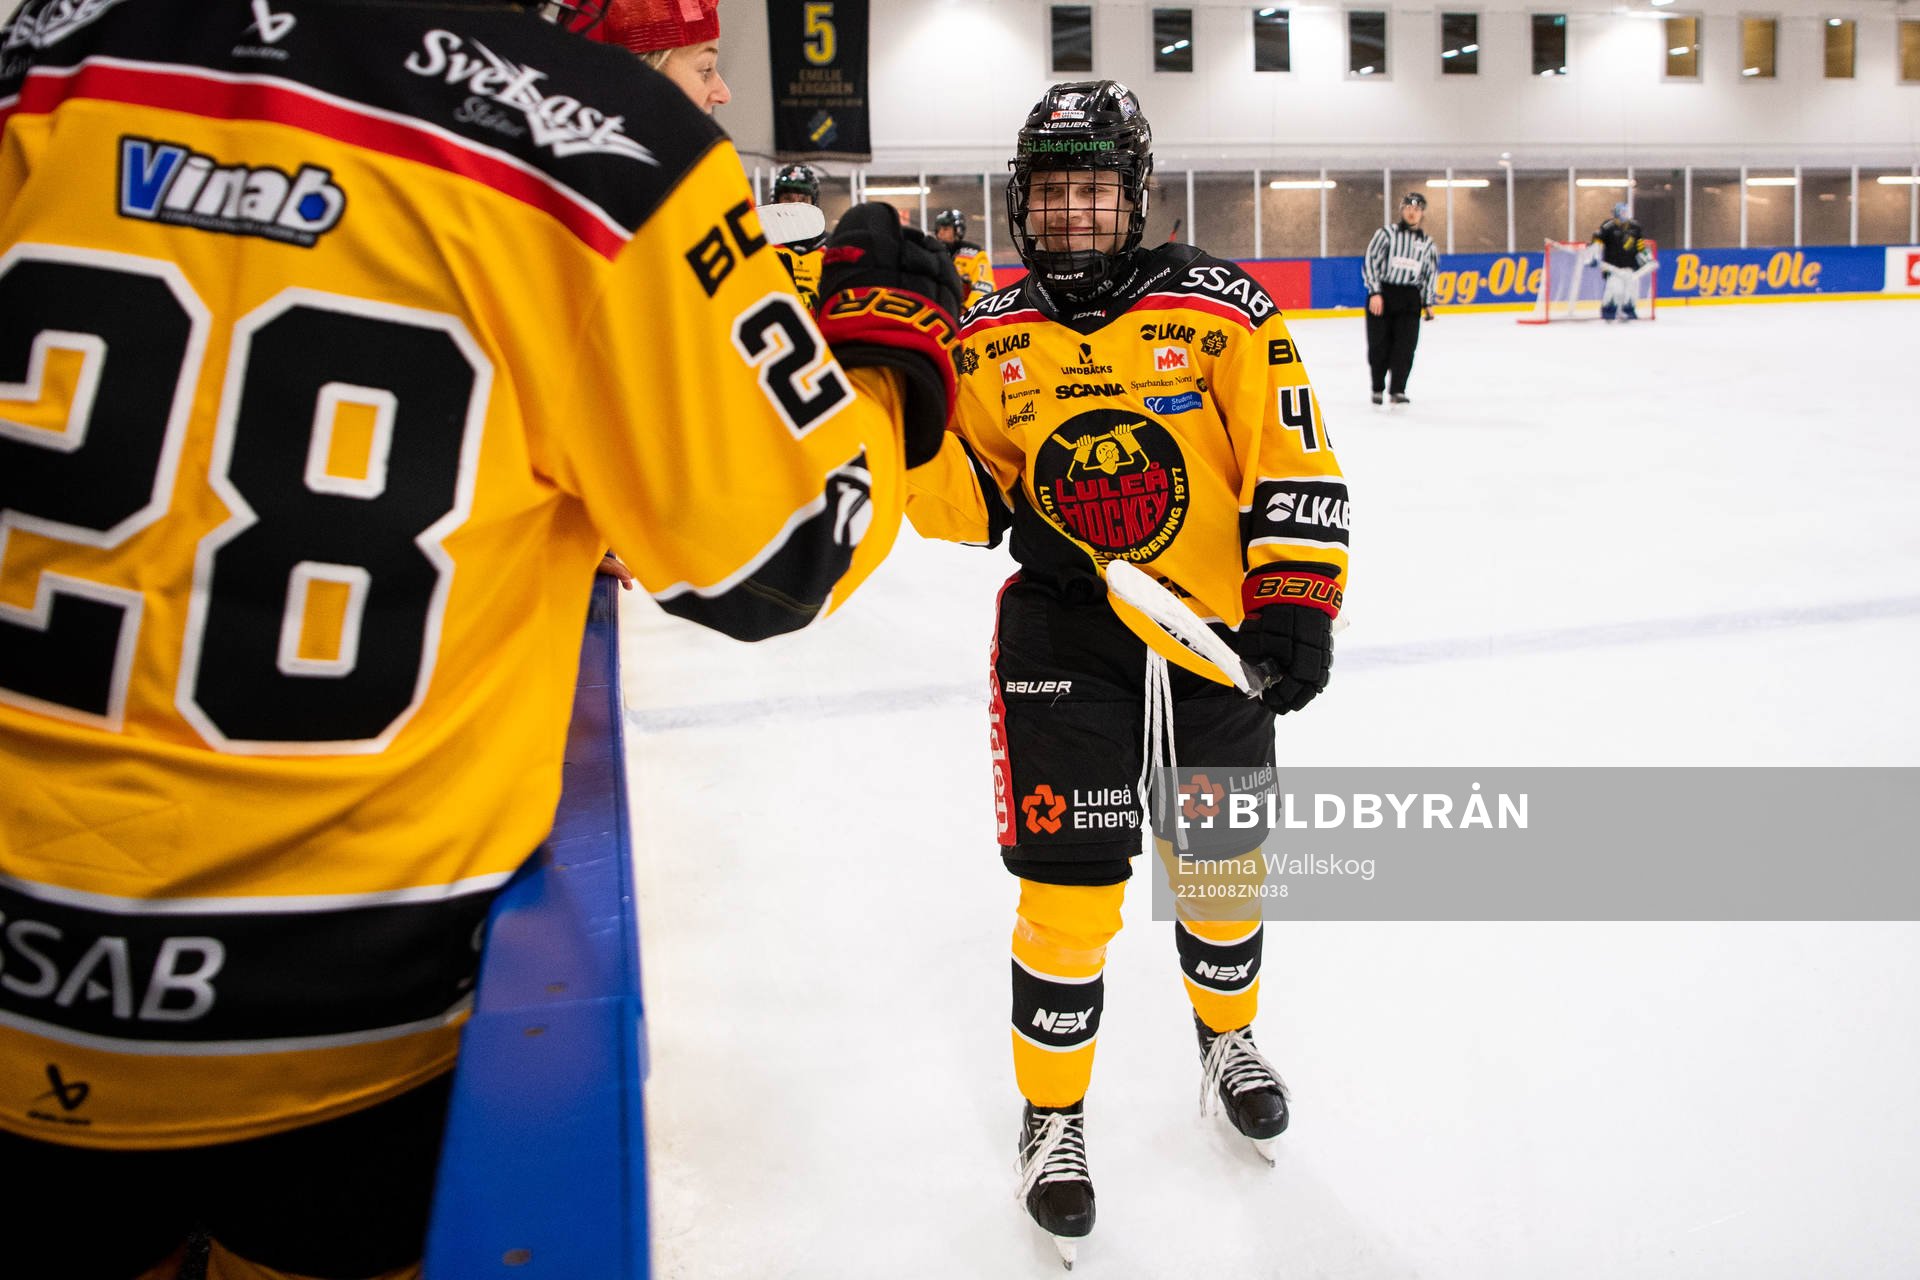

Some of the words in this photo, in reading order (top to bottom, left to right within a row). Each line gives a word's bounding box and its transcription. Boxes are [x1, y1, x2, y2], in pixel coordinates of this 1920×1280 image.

[804, 2, 837, 66] 5
[118, 134, 347, 234] Vinab
[1181, 266, 1275, 318] SSAB
[995, 333, 1030, 357] LKAB
[1158, 322, 1196, 344] LKAB
[1060, 364, 1113, 376] LINDBÄCKS
[1157, 347, 1185, 370] MAX
[1055, 383, 1128, 400] SCANIA
[1130, 377, 1174, 391] Sparbanken
[1175, 375, 1193, 385] Nord
[1171, 394, 1194, 404] Student
[1171, 400, 1202, 411] Consulting
[1055, 461, 1169, 503] LULEÅ
[1171, 467, 1186, 502] 1977
[0, 242, 495, 756] 28
[1059, 491, 1169, 548] HOCKEY
[1005, 680, 1073, 694] BAUER
[1228, 762, 1273, 793] Luleå
[1073, 784, 1132, 807] Luleå
[0, 910, 226, 1022] SAB
[1195, 957, 1255, 982] NEX
[1031, 1006, 1095, 1034] NEX
